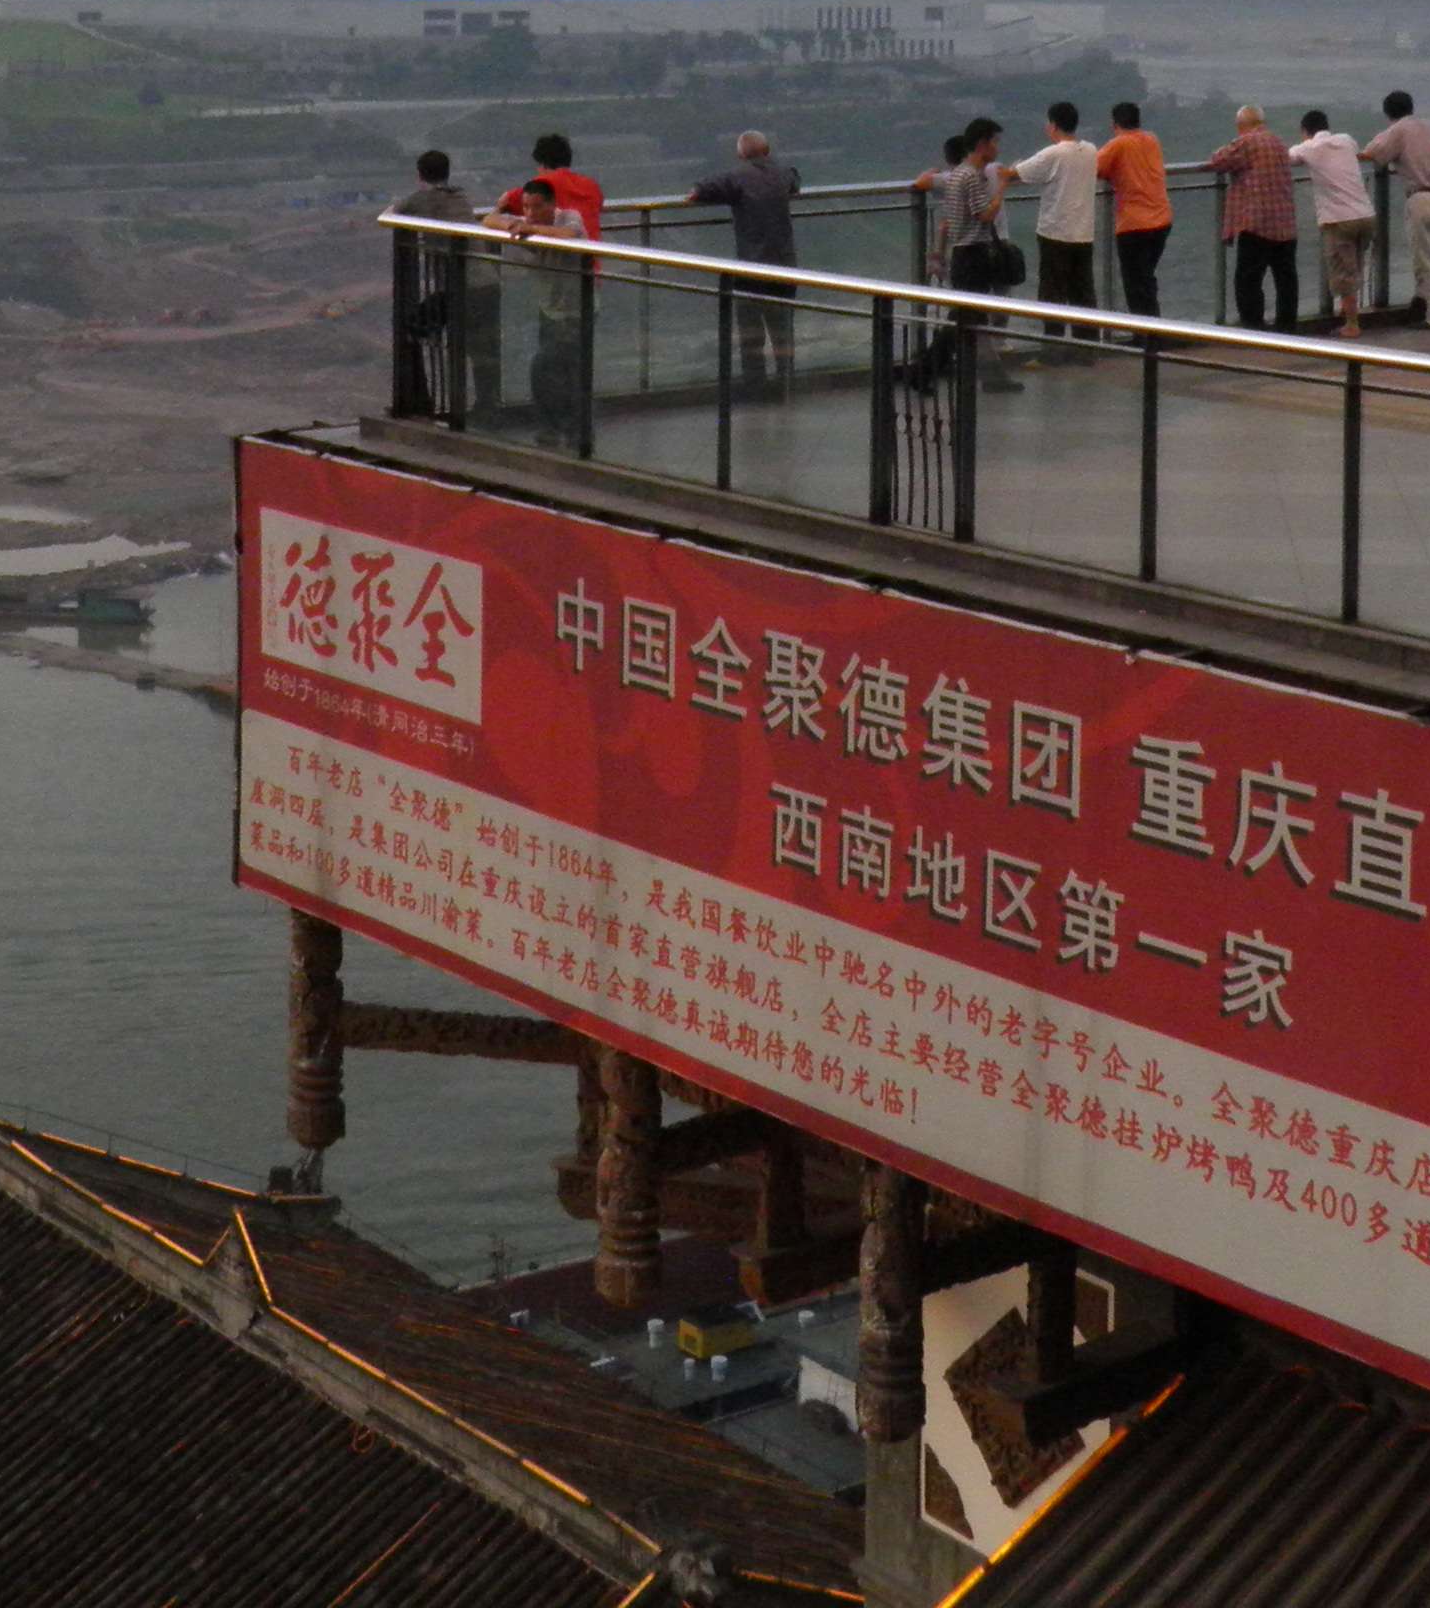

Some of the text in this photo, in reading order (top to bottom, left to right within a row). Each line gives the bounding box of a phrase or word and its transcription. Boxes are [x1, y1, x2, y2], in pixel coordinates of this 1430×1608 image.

[555, 577, 1083, 819] 中国全聚德集团
[771, 783, 1294, 1029] 西南地区第一家
